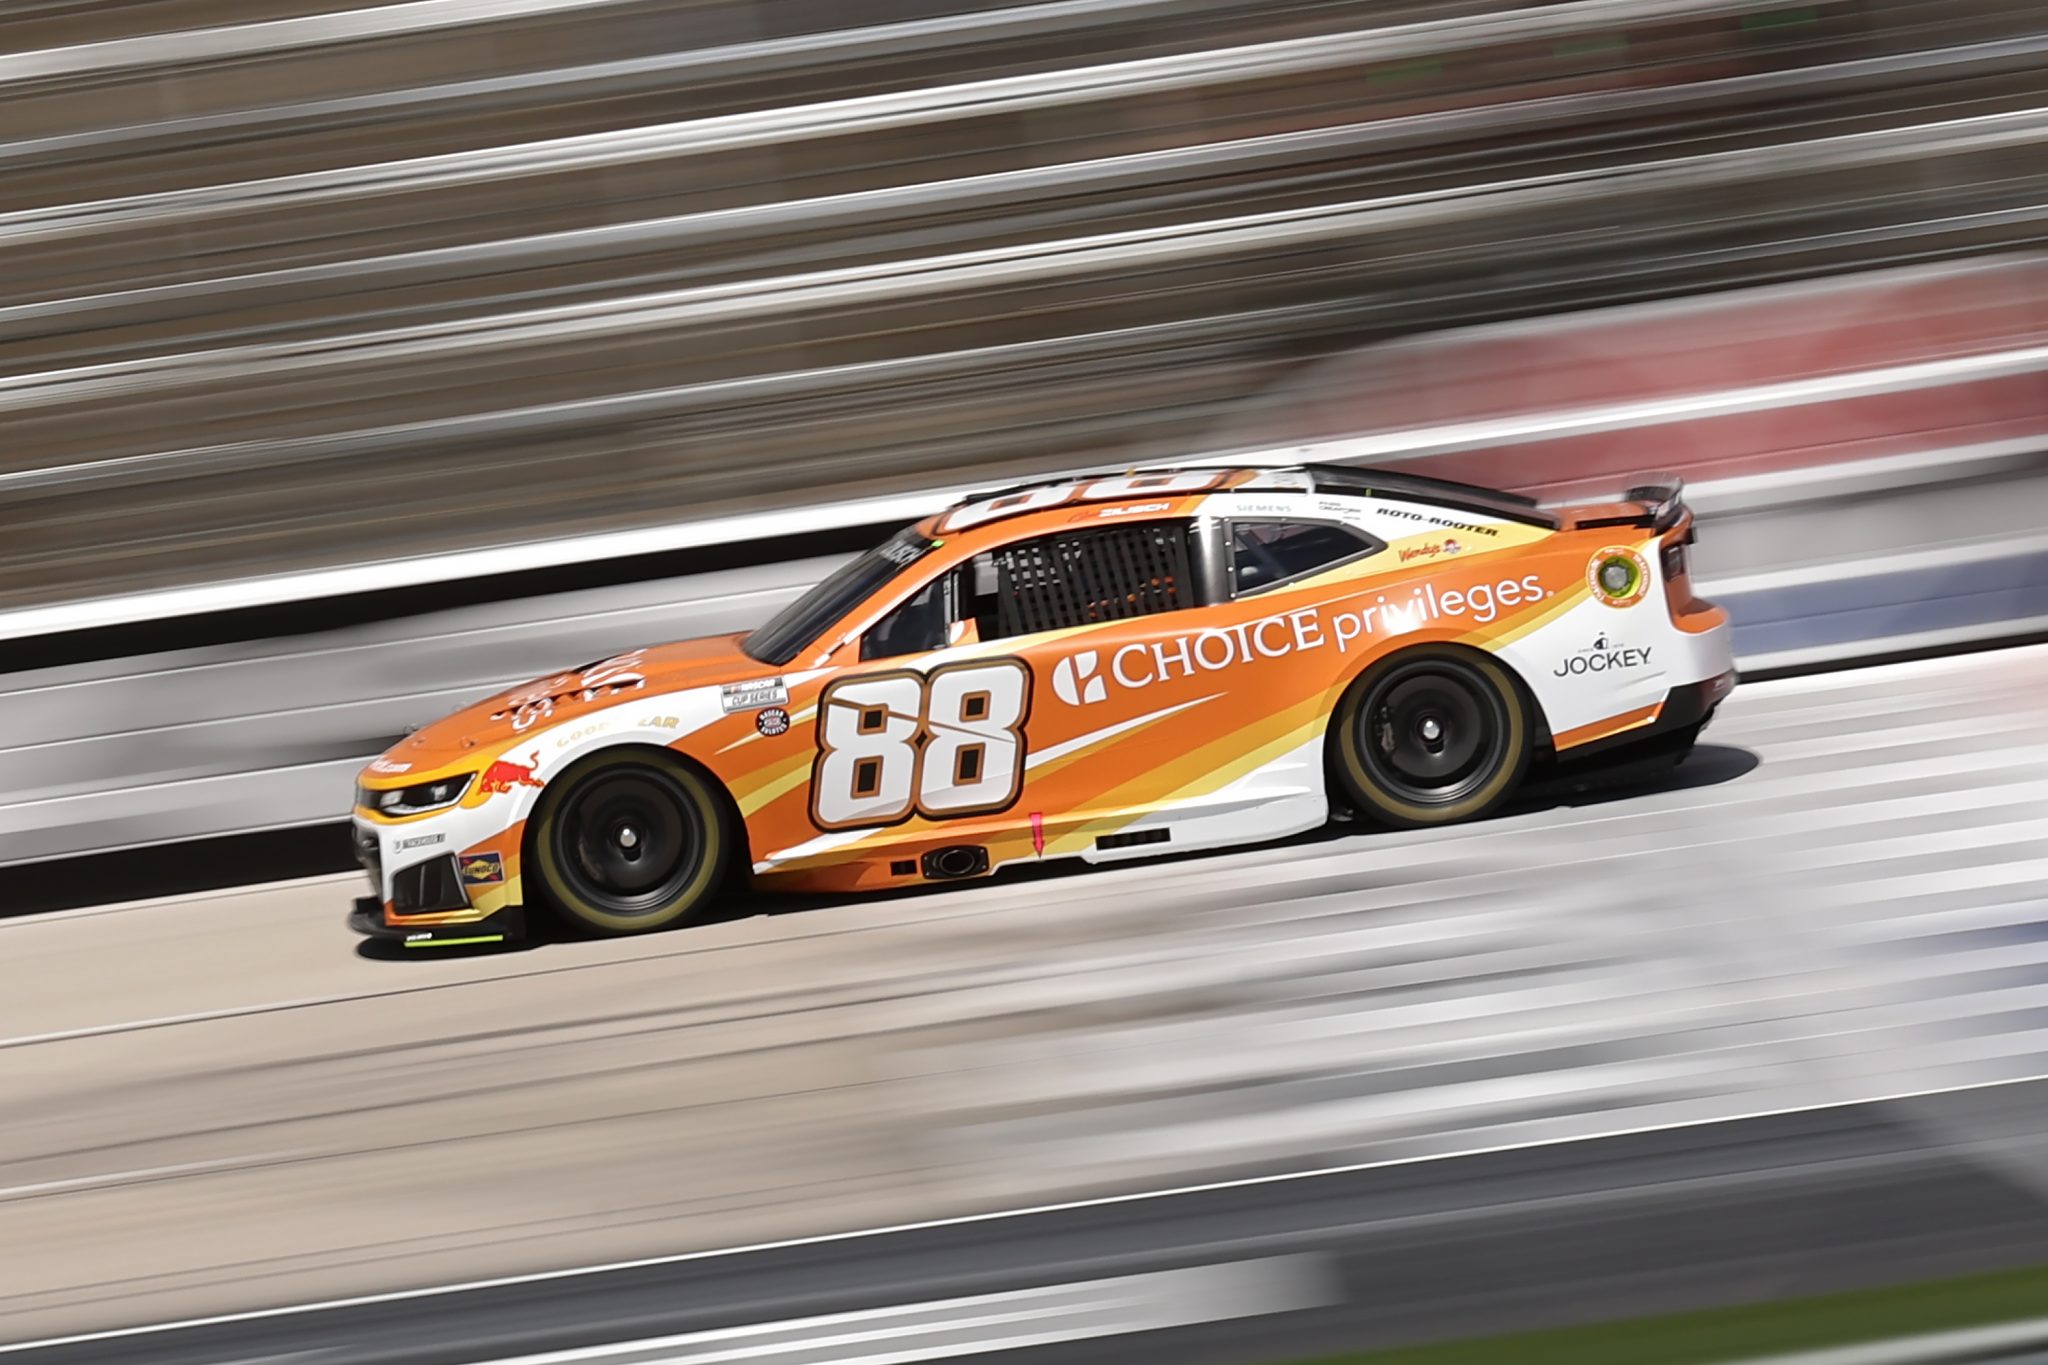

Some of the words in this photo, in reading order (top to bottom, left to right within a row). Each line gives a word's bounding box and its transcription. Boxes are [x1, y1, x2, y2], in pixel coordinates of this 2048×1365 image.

[1236, 504, 1292, 513] SIEMENS
[1376, 507, 1499, 537] ROTO-ROOTER
[1111, 607, 1324, 689] CHOICE
[1553, 646, 1652, 678] JOCKEY
[808, 655, 1034, 834] 88
[463, 861, 499, 875] SUNOCO
